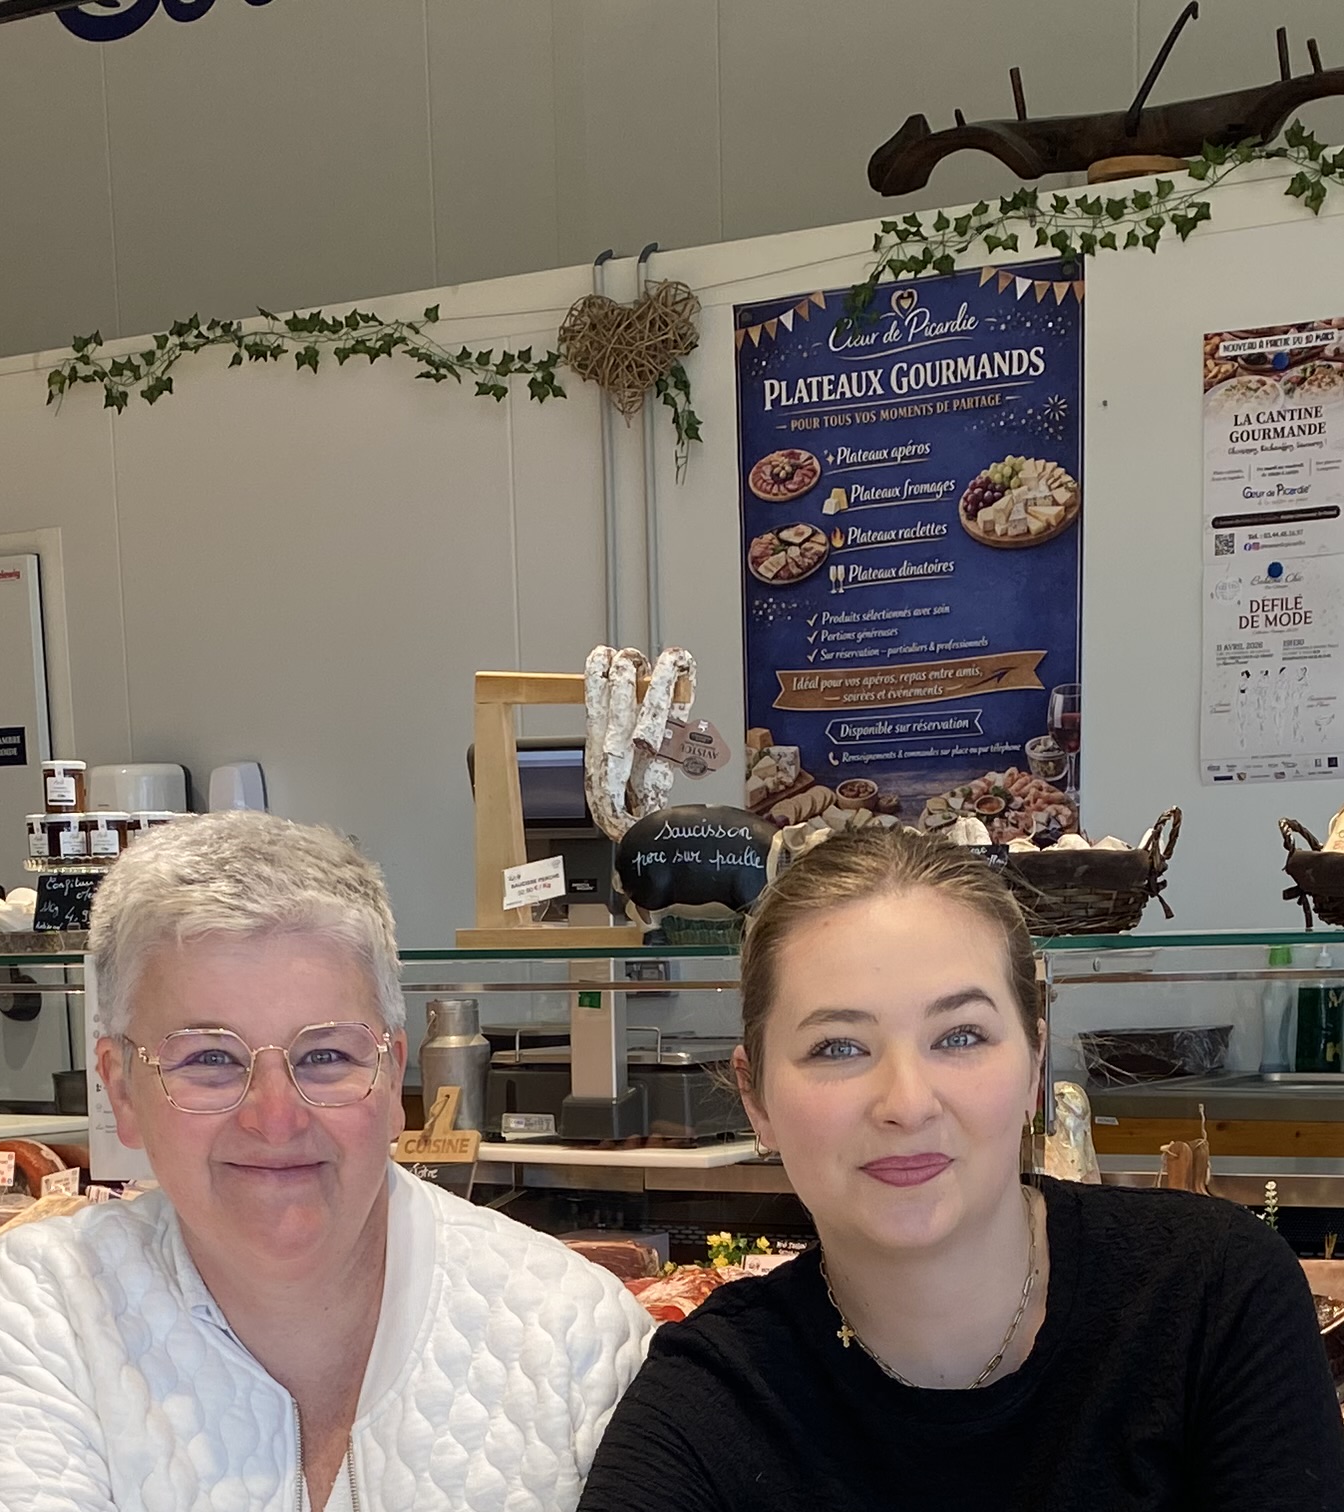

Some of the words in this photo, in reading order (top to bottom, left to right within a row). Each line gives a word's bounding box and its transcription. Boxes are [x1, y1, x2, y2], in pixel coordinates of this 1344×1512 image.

[882, 324, 904, 345] de
[905, 301, 980, 343] Picardie
[762, 368, 885, 412] PLATEAUX
[889, 345, 1046, 394] GOURMANDS
[789, 416, 820, 433] POUR
[822, 412, 853, 429] TOUS
[854, 409, 877, 425] VOS
[878, 402, 934, 423] MOMENTS
[935, 399, 950, 415] DE
[951, 391, 1003, 412] PARTAGE
[1233, 412, 1253, 428] LA
[1255, 405, 1324, 426] CANTINE
[1228, 421, 1327, 444] GOURMANDE
[836, 445, 890, 465] Plateaux
[890, 439, 932, 461] apéros
[850, 482, 901, 503] Plateaux
[901, 477, 957, 501] fromages
[847, 524, 898, 545] Plateaux
[898, 520, 948, 540] raclettes
[848, 564, 898, 584] Plateaux
[898, 559, 955, 579] dînatoires
[821, 611, 861, 626] Produits
[861, 608, 912, 622] sélectionnés
[912, 606, 932, 617] avec
[932, 604, 950, 616] soin
[1249, 593, 1304, 614] DÉFILÉ
[1238, 614, 1260, 630] DE
[1264, 609, 1314, 628] MODE
[820, 629, 856, 643] Portions
[856, 627, 899, 644] généreuses
[820, 648, 836, 661] Sur
[835, 647, 880, 660] réservation
[886, 641, 928, 658] particuliers
[929, 641, 936, 652] &
[935, 635, 989, 654] professionnels
[792, 674, 819, 692] Idéal
[820, 676, 843, 692] pour
[844, 676, 861, 687] vos
[862, 671, 898, 690] apéros,
[899, 669, 928, 687] repas
[928, 667, 955, 681] entre
[955, 663, 983, 678] amis,
[842, 689, 876, 704] soirées
[877, 689, 887, 700] et
[887, 684, 944, 700] événements
[839, 719, 893, 740] Disponible
[894, 721, 911, 734] sur
[912, 716, 970, 733] réservation
[842, 750, 897, 765] Renseignements
[990, 741, 1022, 755] téléphone
[632, 850, 668, 877] porc
[672, 848, 703, 865] sur
[708, 845, 765, 871] paille
[404, 1138, 471, 1155] CUISINE
